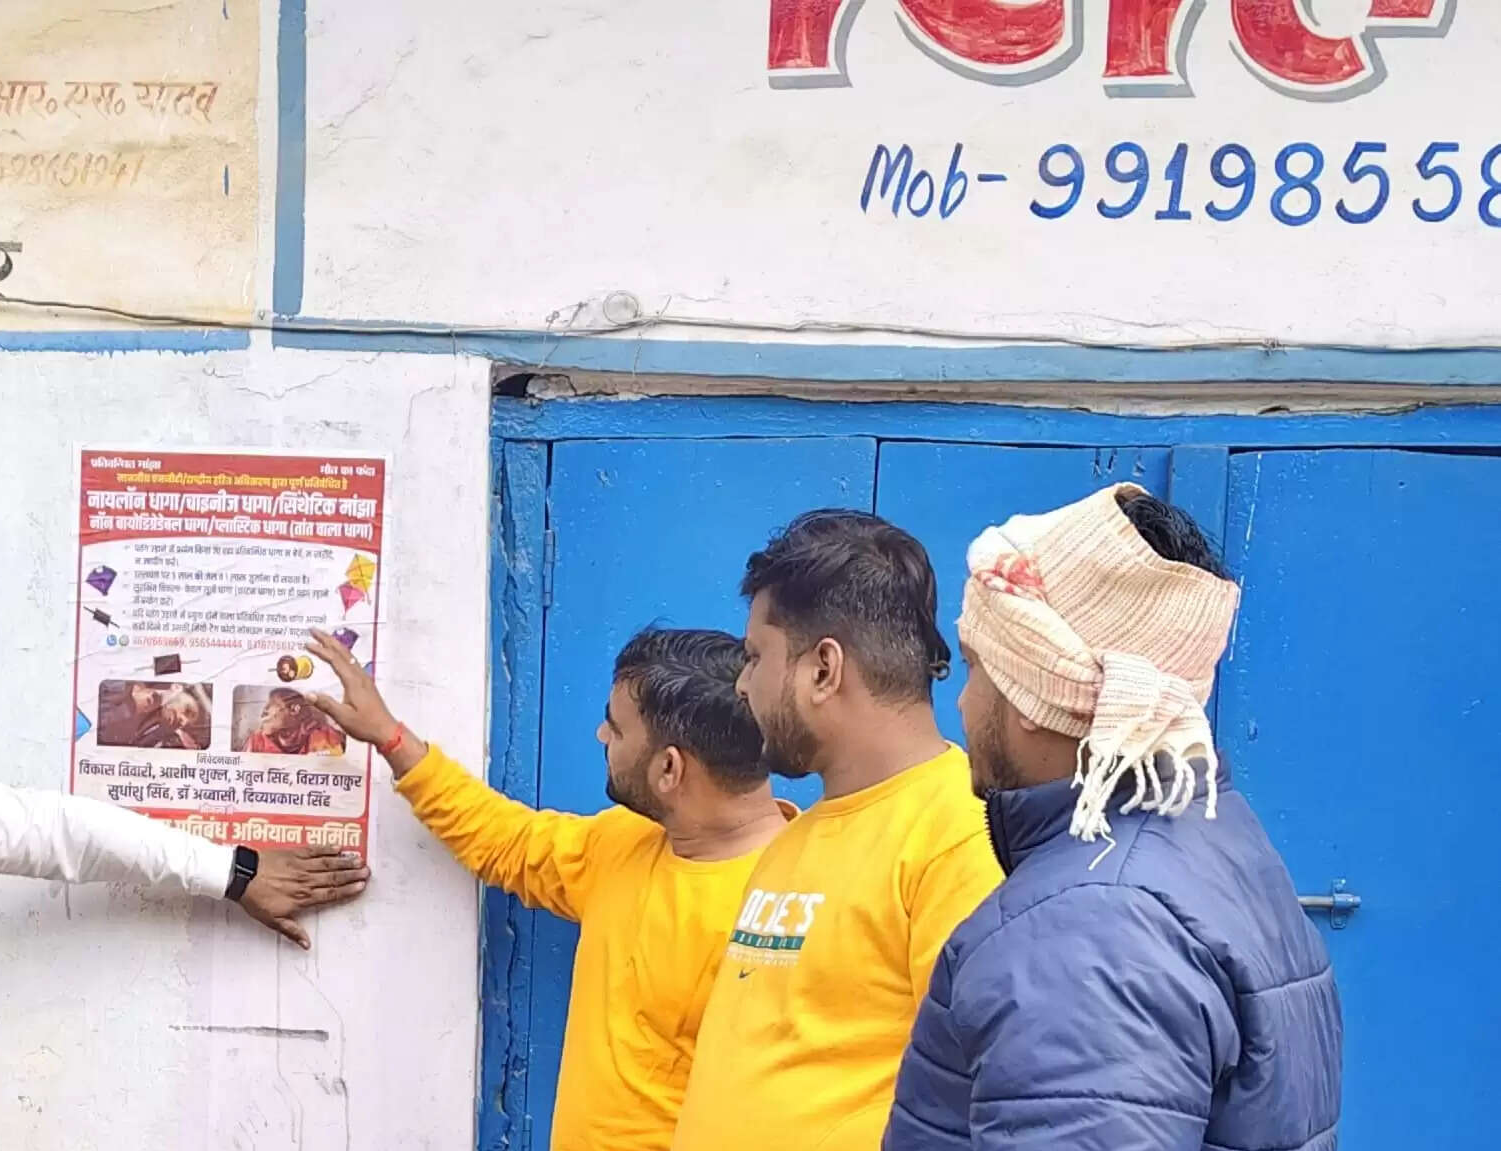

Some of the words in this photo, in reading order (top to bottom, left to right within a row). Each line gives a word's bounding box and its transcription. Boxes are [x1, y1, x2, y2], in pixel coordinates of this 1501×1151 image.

[86, 485, 147, 509] नायलॉन
[79, 758, 115, 776] विकास
[235, 769, 264, 786] अतुल
[296, 769, 331, 787] विराज
[331, 773, 362, 791] ठाकुर
[107, 781, 144, 801] सुधांशु
[176, 783, 192, 800] डॉ
[306, 790, 331, 807] सिंह
[231, 817, 304, 844] अभियान
[305, 821, 363, 847] समिति
